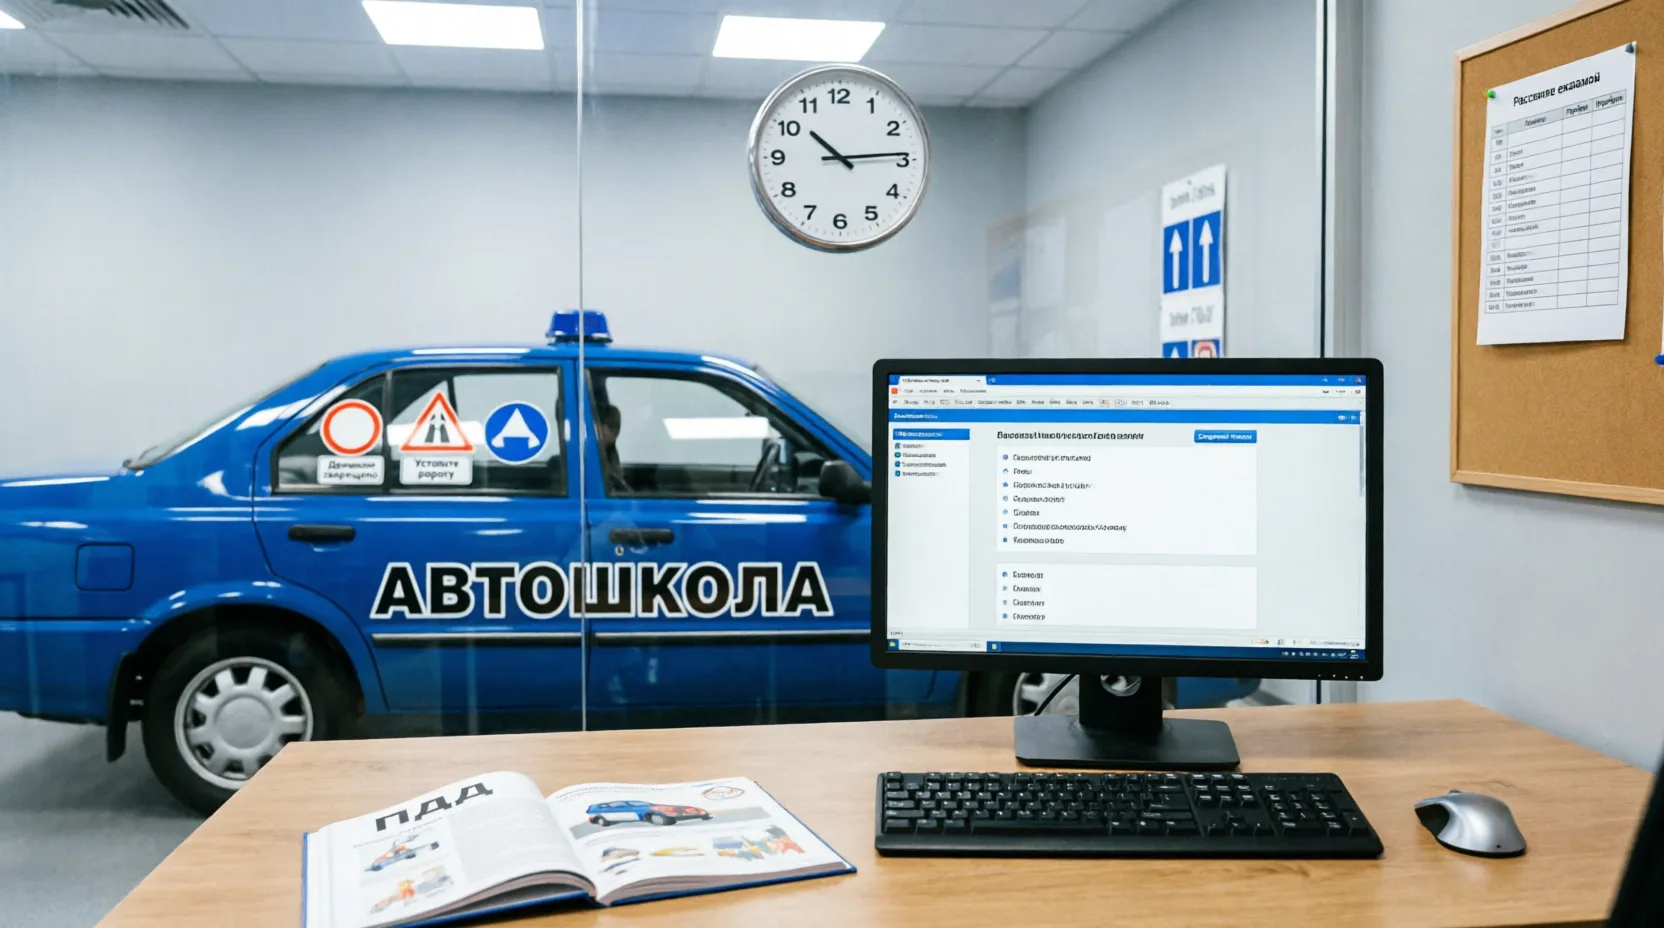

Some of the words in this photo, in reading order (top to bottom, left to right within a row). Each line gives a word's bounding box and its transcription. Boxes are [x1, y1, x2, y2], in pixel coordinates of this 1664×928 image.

[827, 88, 851, 104] 12
[799, 97, 818, 114] 11
[866, 97, 875, 114] 1
[778, 120, 801, 137] 10
[886, 120, 901, 137] 2
[770, 149, 786, 166] 9
[895, 152, 910, 168] 3
[780, 181, 797, 198] 8
[885, 183, 900, 199] 4
[803, 204, 817, 221] 7
[864, 205, 879, 221] 5
[832, 213, 848, 230] 6
[369, 562, 835, 620] АВТОШКОЛА
[375, 782, 494, 832] ПДД
